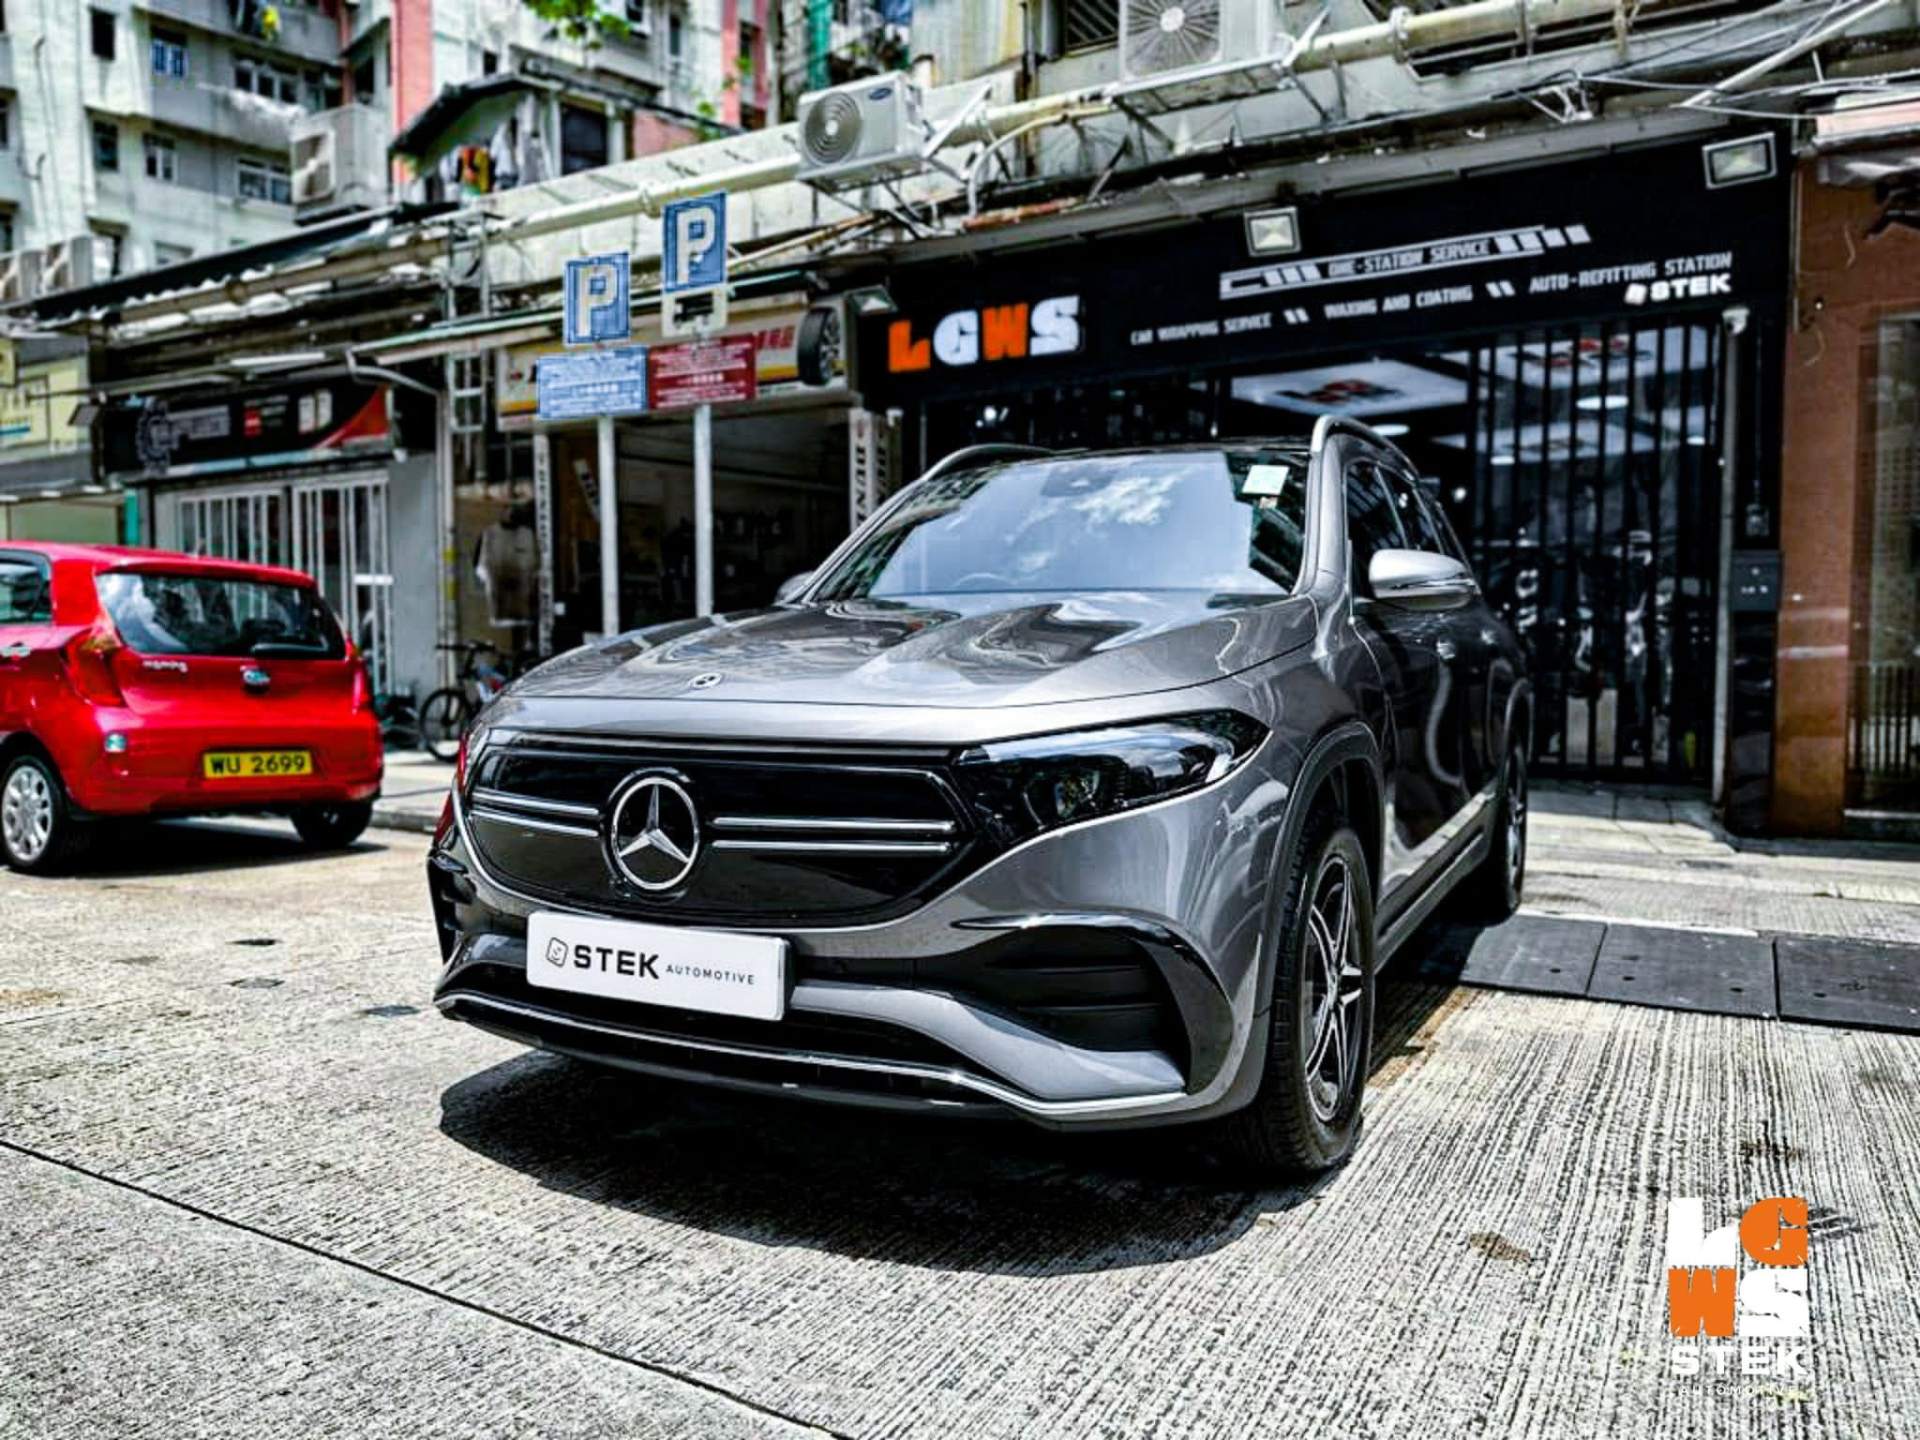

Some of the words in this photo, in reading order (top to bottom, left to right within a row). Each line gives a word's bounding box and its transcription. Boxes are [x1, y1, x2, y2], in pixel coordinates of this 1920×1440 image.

[675, 204, 716, 283] P
[1429, 240, 1490, 263] SERVICE
[1529, 262, 1656, 294] AUTO-REFITTING
[1664, 252, 1732, 276] STATION
[1649, 274, 1731, 302] STEK
[574, 264, 618, 338] P
[1382, 294, 1411, 312] AND
[1415, 285, 1474, 308] COATING
[888, 294, 1080, 373] LGWS
[1223, 312, 1273, 334] SERVICE
[210, 756, 241, 774] WU
[250, 754, 306, 774] 2699
[573, 944, 660, 980] STEK
[666, 964, 755, 985] AUTOMOTIVE
